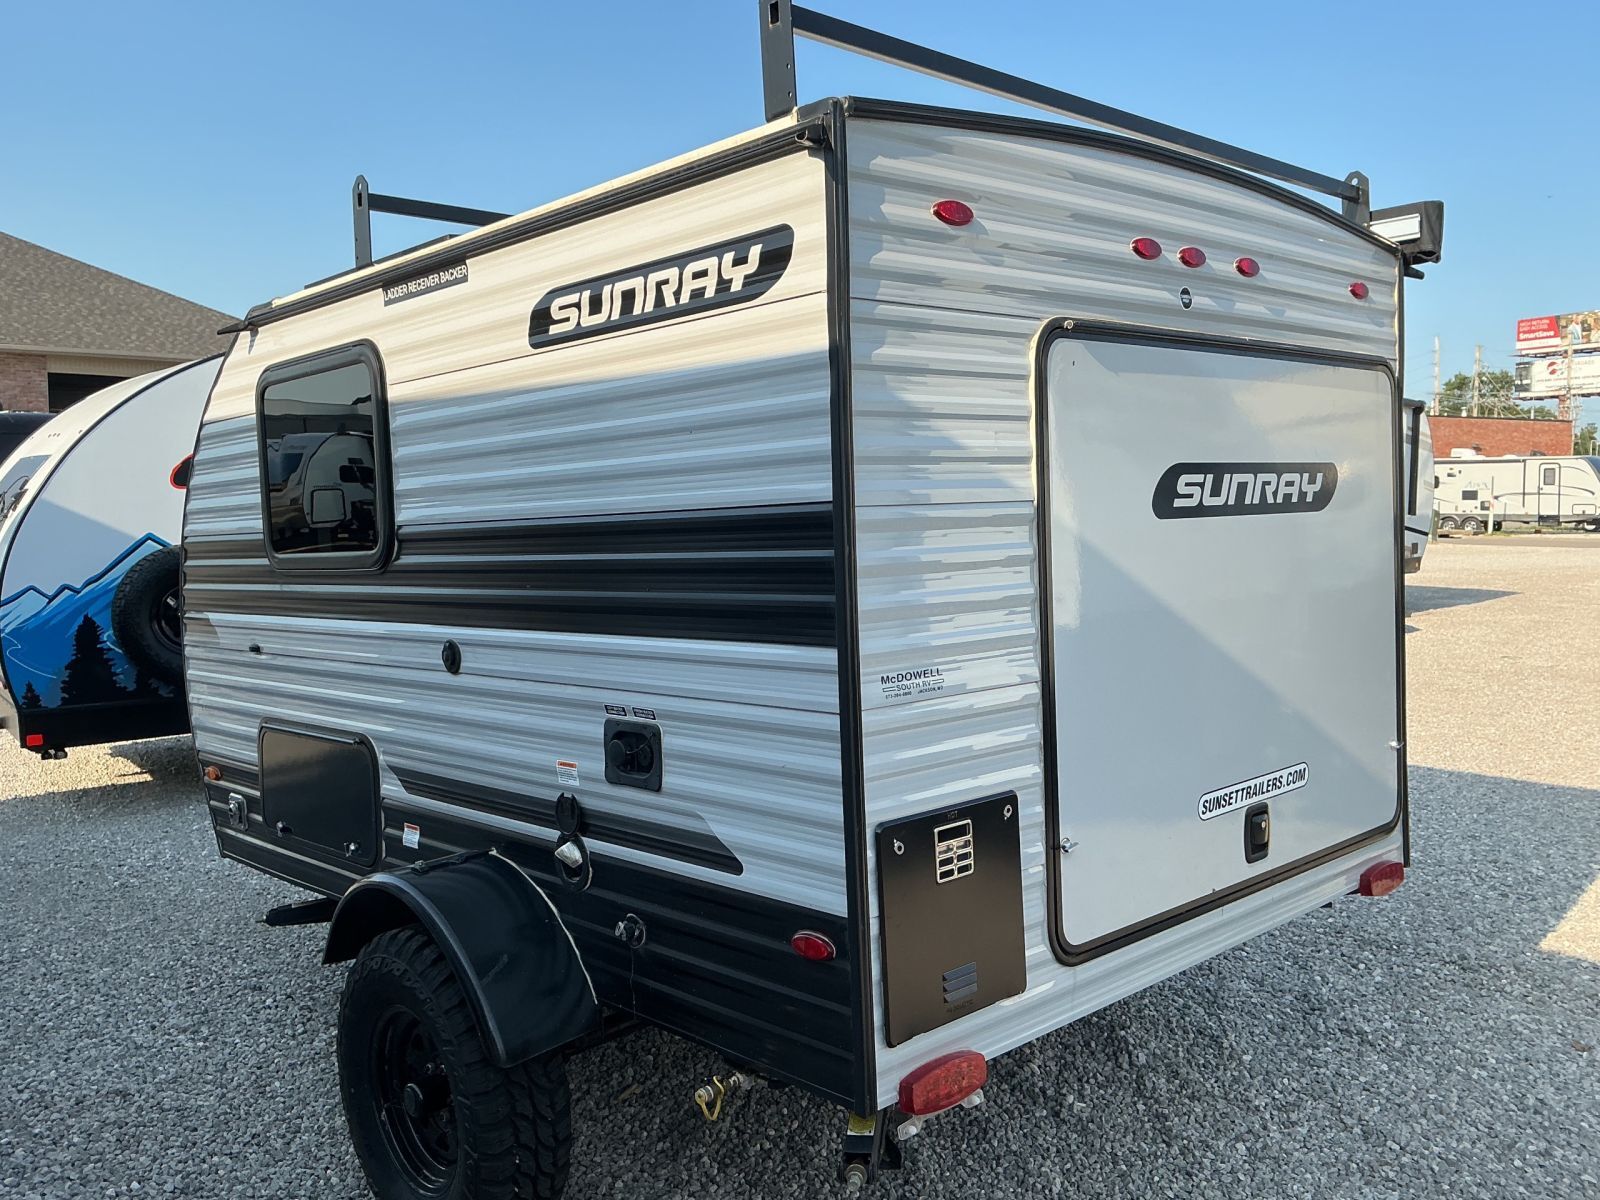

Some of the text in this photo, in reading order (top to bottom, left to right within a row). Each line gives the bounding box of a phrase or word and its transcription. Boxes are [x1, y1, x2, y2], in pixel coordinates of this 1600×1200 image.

[384, 264, 468, 301] LADDER RECEIVER BACKER
[548, 243, 763, 335] SUNRAY
[1172, 472, 1324, 508] SUNRAY
[880, 667, 944, 685] McDOWELL
[896, 679, 932, 692] SOUTH RV
[1201, 766, 1307, 816] SUNSETTRAILERS.COM
